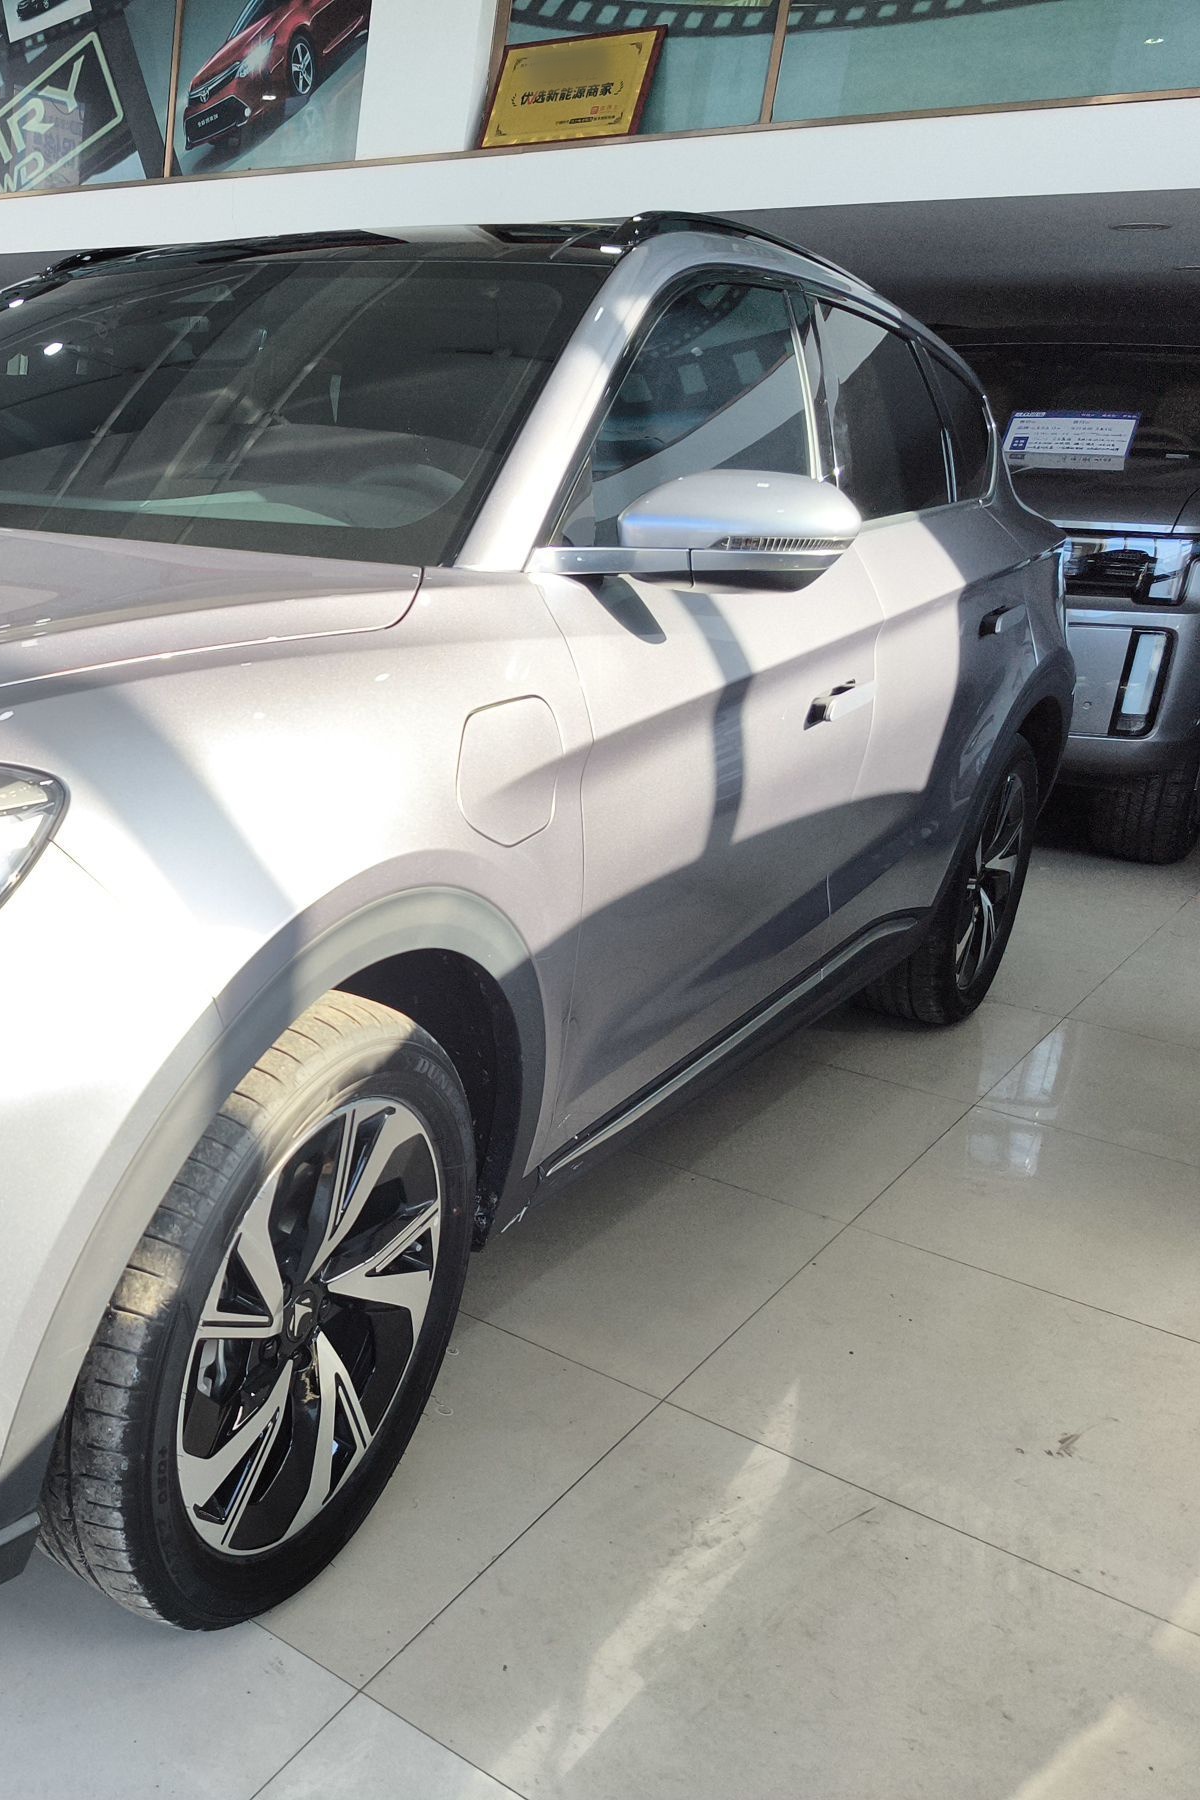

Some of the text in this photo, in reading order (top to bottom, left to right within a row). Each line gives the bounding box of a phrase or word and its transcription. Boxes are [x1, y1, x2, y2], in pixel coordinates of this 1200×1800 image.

[520, 82, 614, 107] 优选新能源商家
